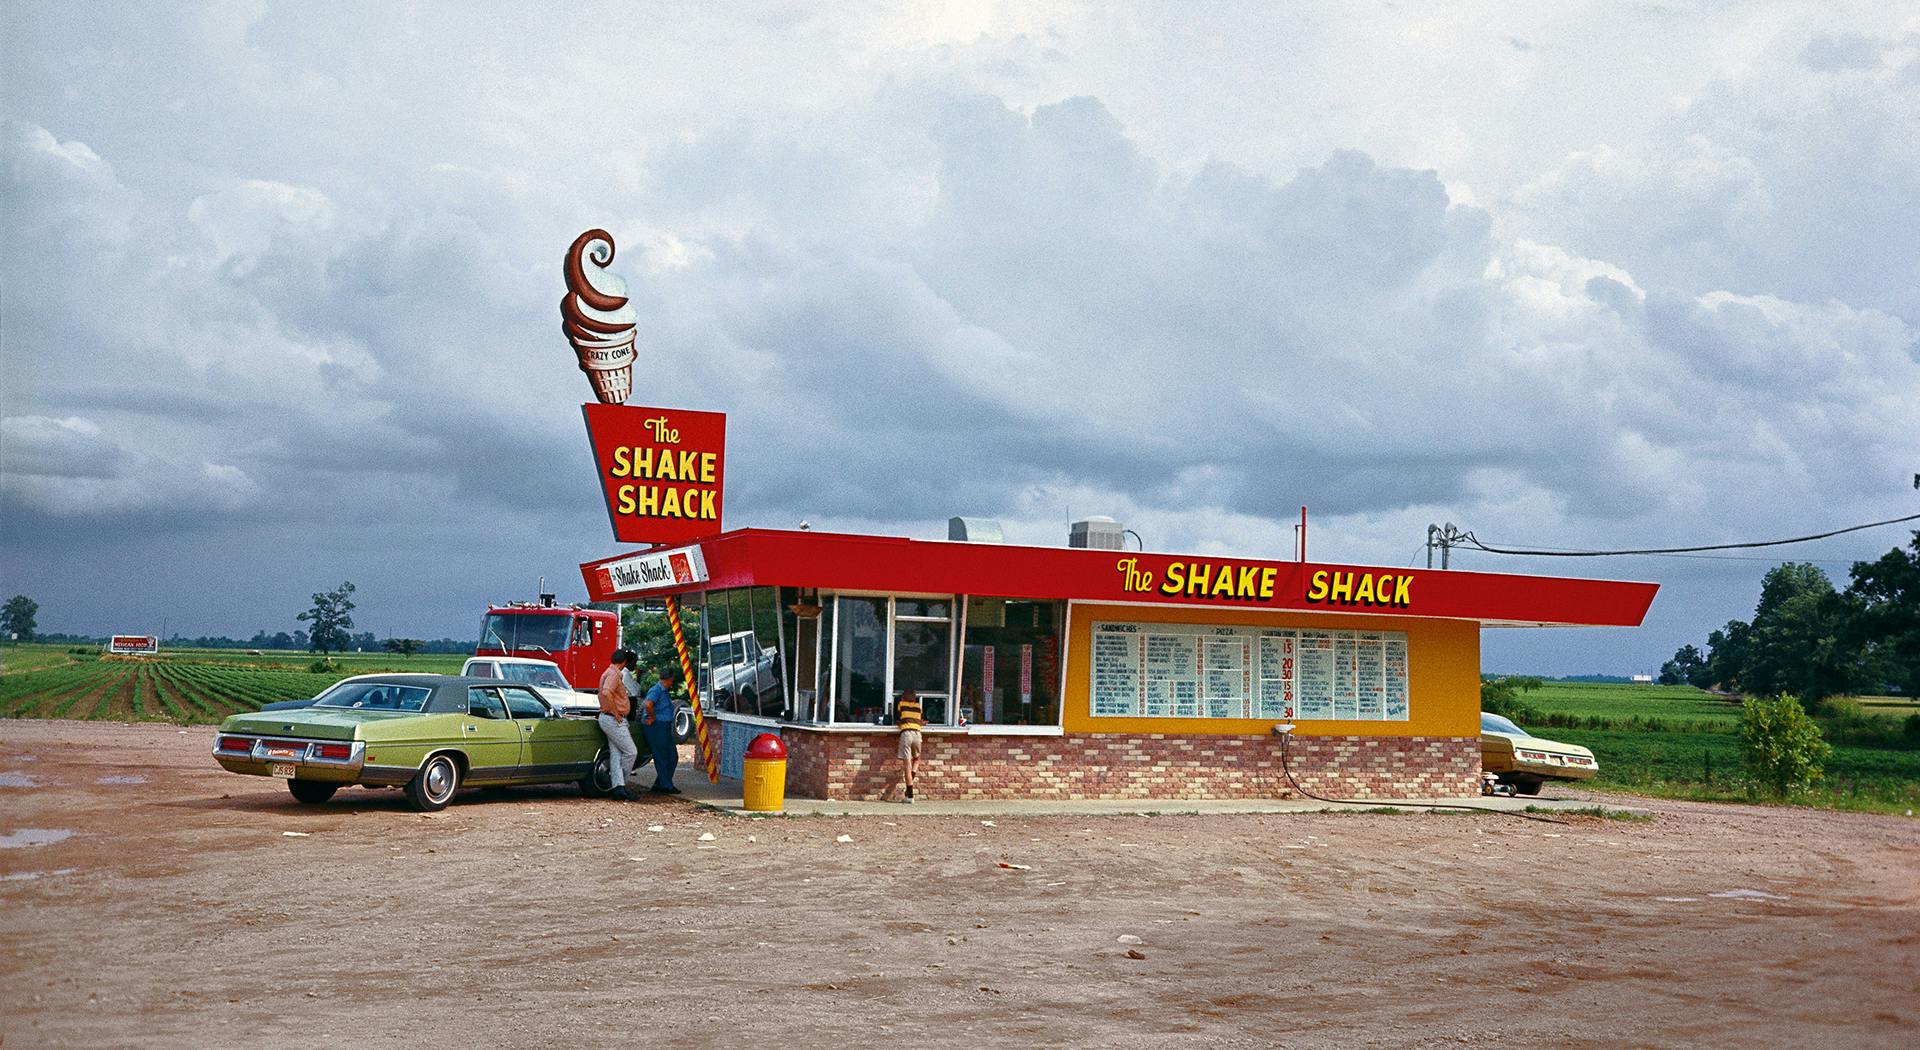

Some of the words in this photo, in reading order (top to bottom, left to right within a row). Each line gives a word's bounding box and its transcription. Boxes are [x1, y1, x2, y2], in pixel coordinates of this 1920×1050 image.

[584, 350, 609, 361] CRAZY
[611, 347, 631, 360] CONE
[643, 415, 681, 444] The
[611, 446, 718, 484] SHAKE
[617, 484, 718, 519] SHACK
[614, 564, 641, 587] Shake
[640, 558, 671, 584] Shack
[1116, 556, 1153, 593] The
[1161, 562, 1279, 599] SHAKE
[1307, 569, 1415, 607] SHACK
[1101, 624, 1137, 632] SANDWICHES
[1216, 628, 1233, 636] PIZZA
[1283, 642, 1292, 654] 15
[1282, 658, 1293, 669] 20
[1282, 670, 1293, 680] 30
[1284, 681, 1291, 690] 15
[1284, 691, 1293, 701] 20
[1284, 707, 1294, 718] 30
